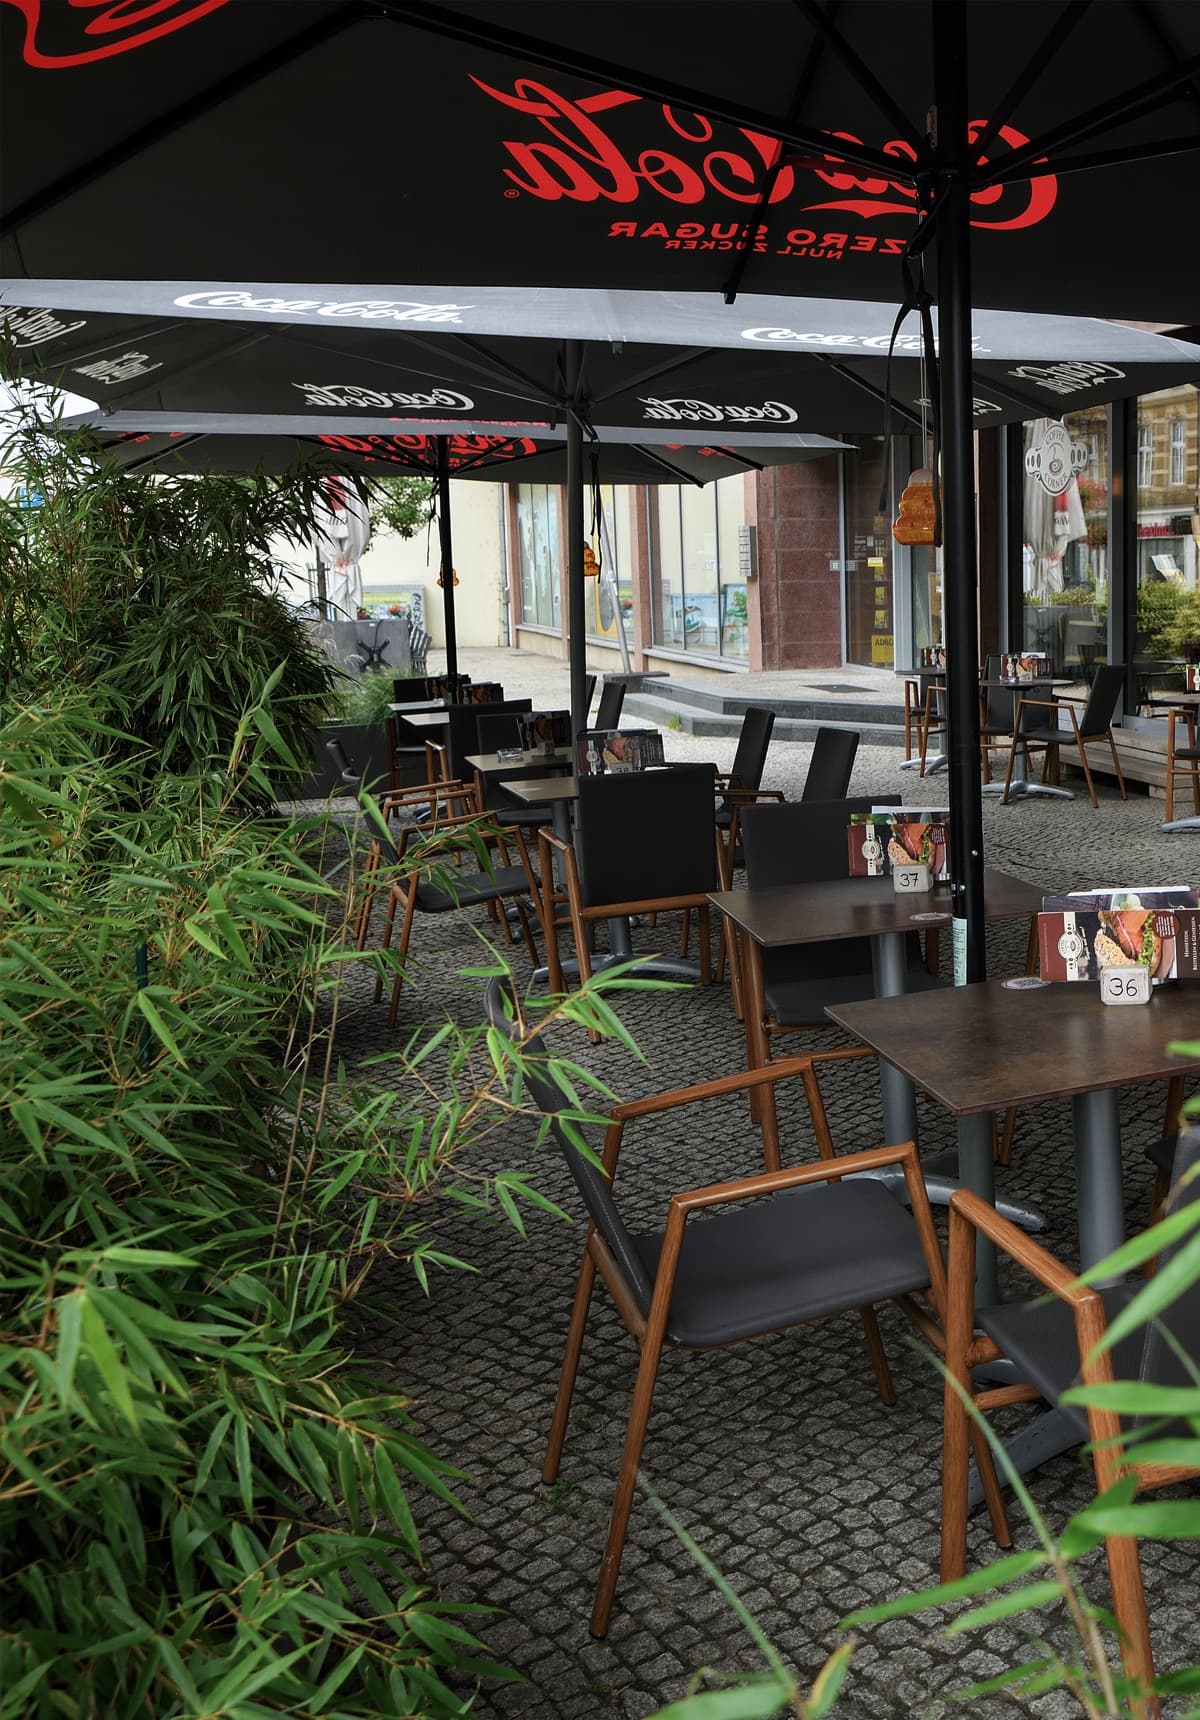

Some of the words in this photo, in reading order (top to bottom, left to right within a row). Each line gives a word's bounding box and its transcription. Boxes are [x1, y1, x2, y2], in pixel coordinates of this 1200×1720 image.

[173, 291, 476, 324] Coca-Cola
[740, 326, 992, 353] Coca-Co
[1045, 429, 1064, 445] COFFEE
[1044, 472, 1067, 489] CORNER
[899, 872, 920, 888] 37
[1108, 976, 1139, 997] 36
